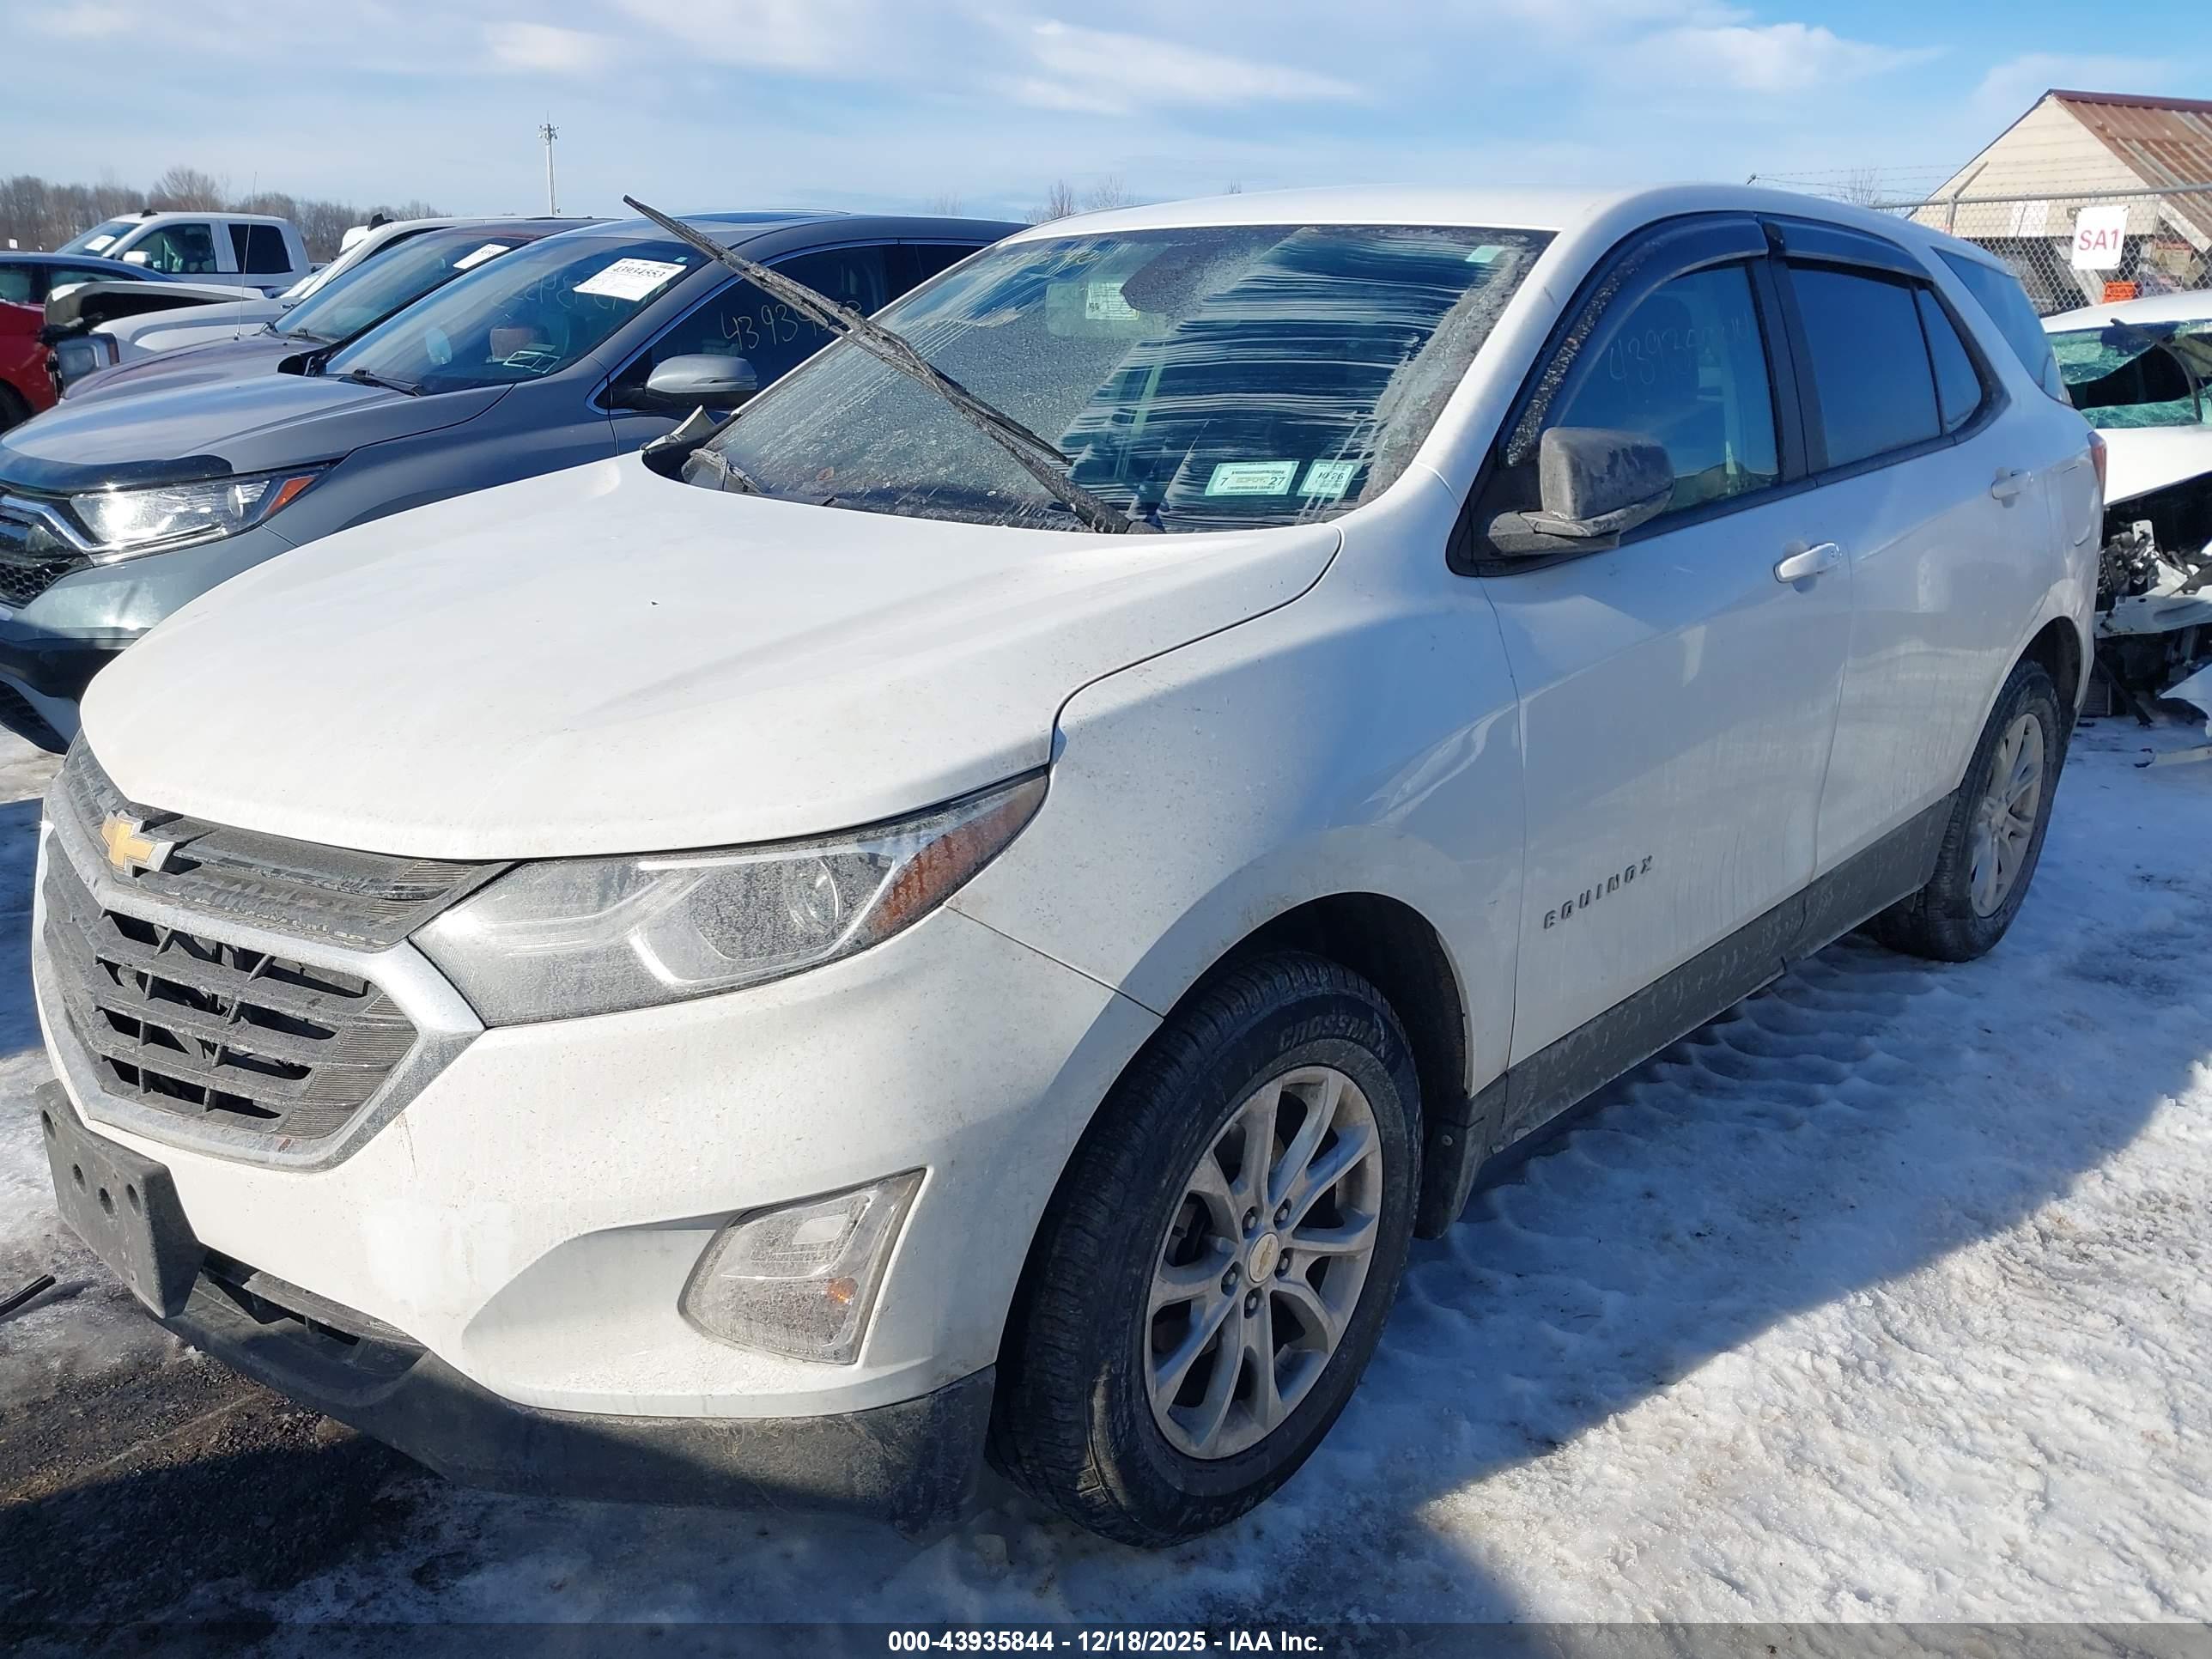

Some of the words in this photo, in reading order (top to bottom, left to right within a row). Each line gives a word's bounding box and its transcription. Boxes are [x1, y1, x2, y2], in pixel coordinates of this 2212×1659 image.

[2078, 228, 2120, 251] SA1
[1219, 477, 1229, 487] 7
[1268, 476, 1286, 487] 27
[1543, 855, 1653, 930] EQUINOX
